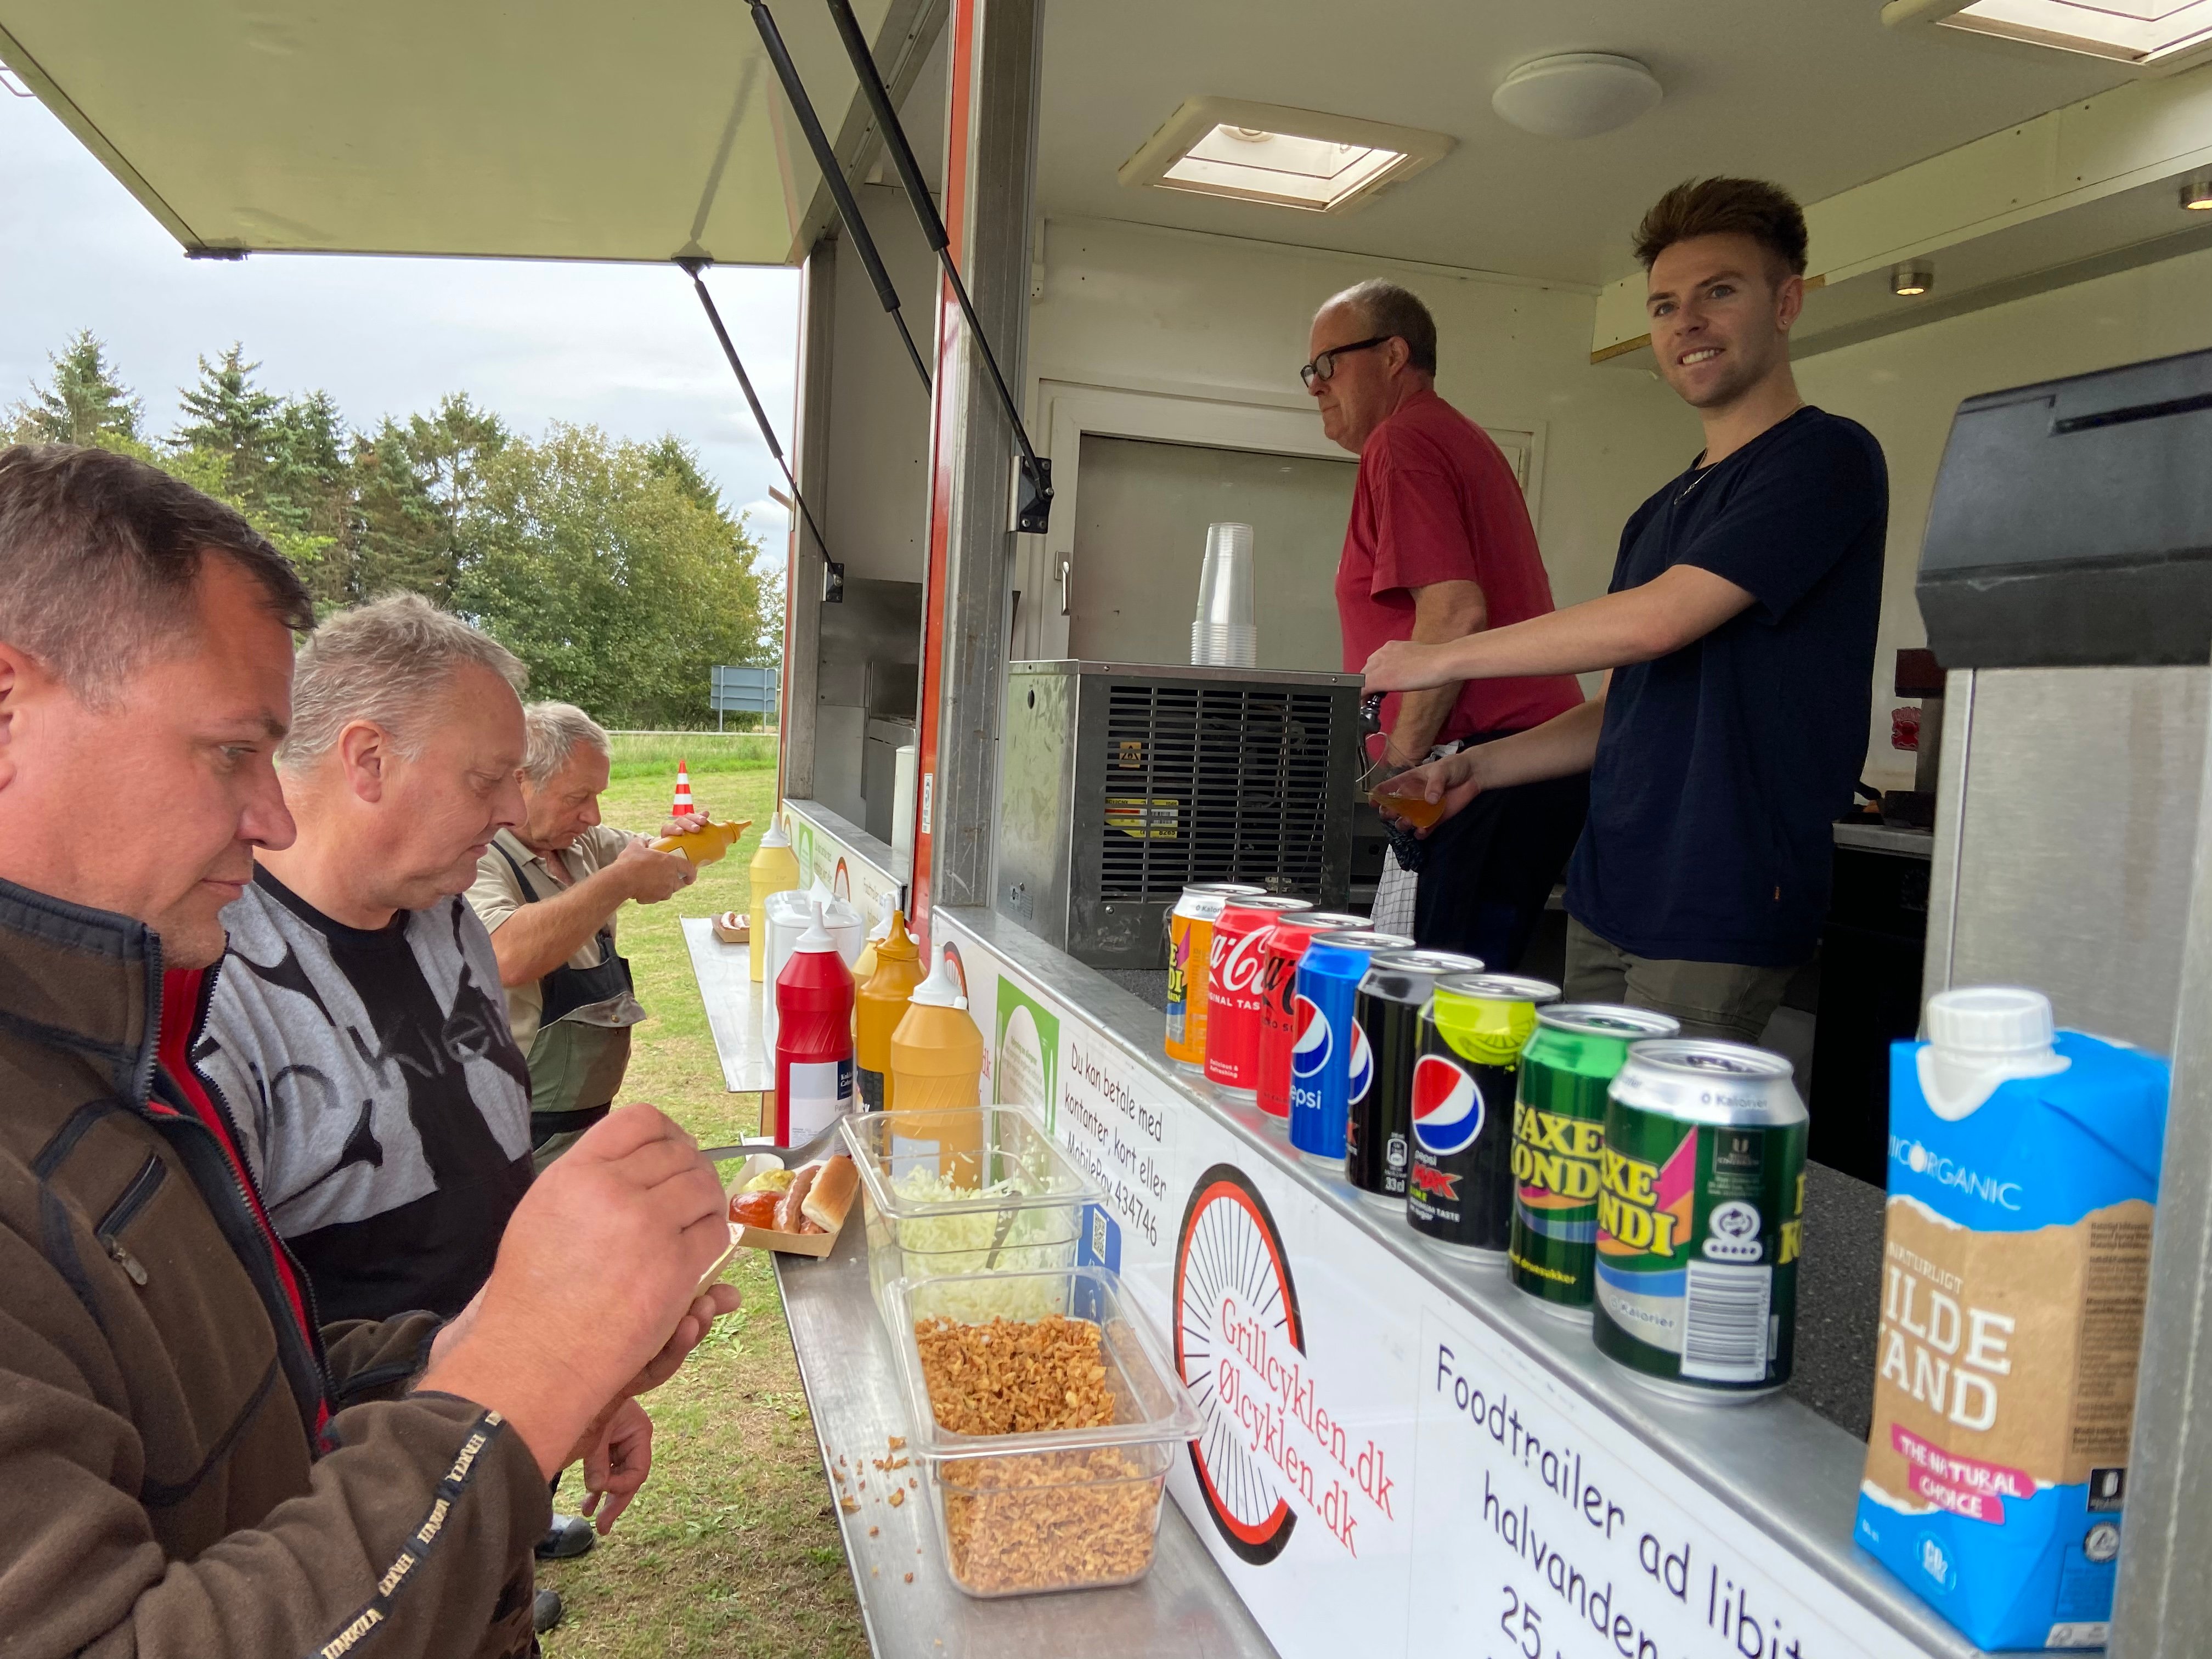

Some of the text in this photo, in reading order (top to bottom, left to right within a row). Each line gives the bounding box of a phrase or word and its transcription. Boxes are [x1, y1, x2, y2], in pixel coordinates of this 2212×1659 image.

[1209, 994, 1233, 1007] GINAL
[1071, 1042, 1084, 1076] Du
[1085, 1057, 1101, 1091] kan
[1103, 1069, 1136, 1120] betale
[1138, 1099, 1163, 1143] med
[1701, 1093, 1712, 1105] 0
[1114, 1126, 1137, 1174] kort
[1140, 1153, 1167, 1201] eller
[1115, 1180, 1157, 1247] 434746
[1887, 1240, 1964, 1295] NATURLIGT
[1222, 1297, 1395, 1523] Grillcyklen.dk
[1880, 1323, 1999, 1432] AND
[1218, 1358, 1358, 1561] Ølcyklen.dk
[1436, 1342, 1626, 1540] Foodtrailer
[1639, 1532, 1691, 1604] ad
[1900, 1435, 2022, 1498] THE NATURAL
[1921, 1476, 1983, 1519] CHOICE
[1500, 1584, 1543, 1659] 25
